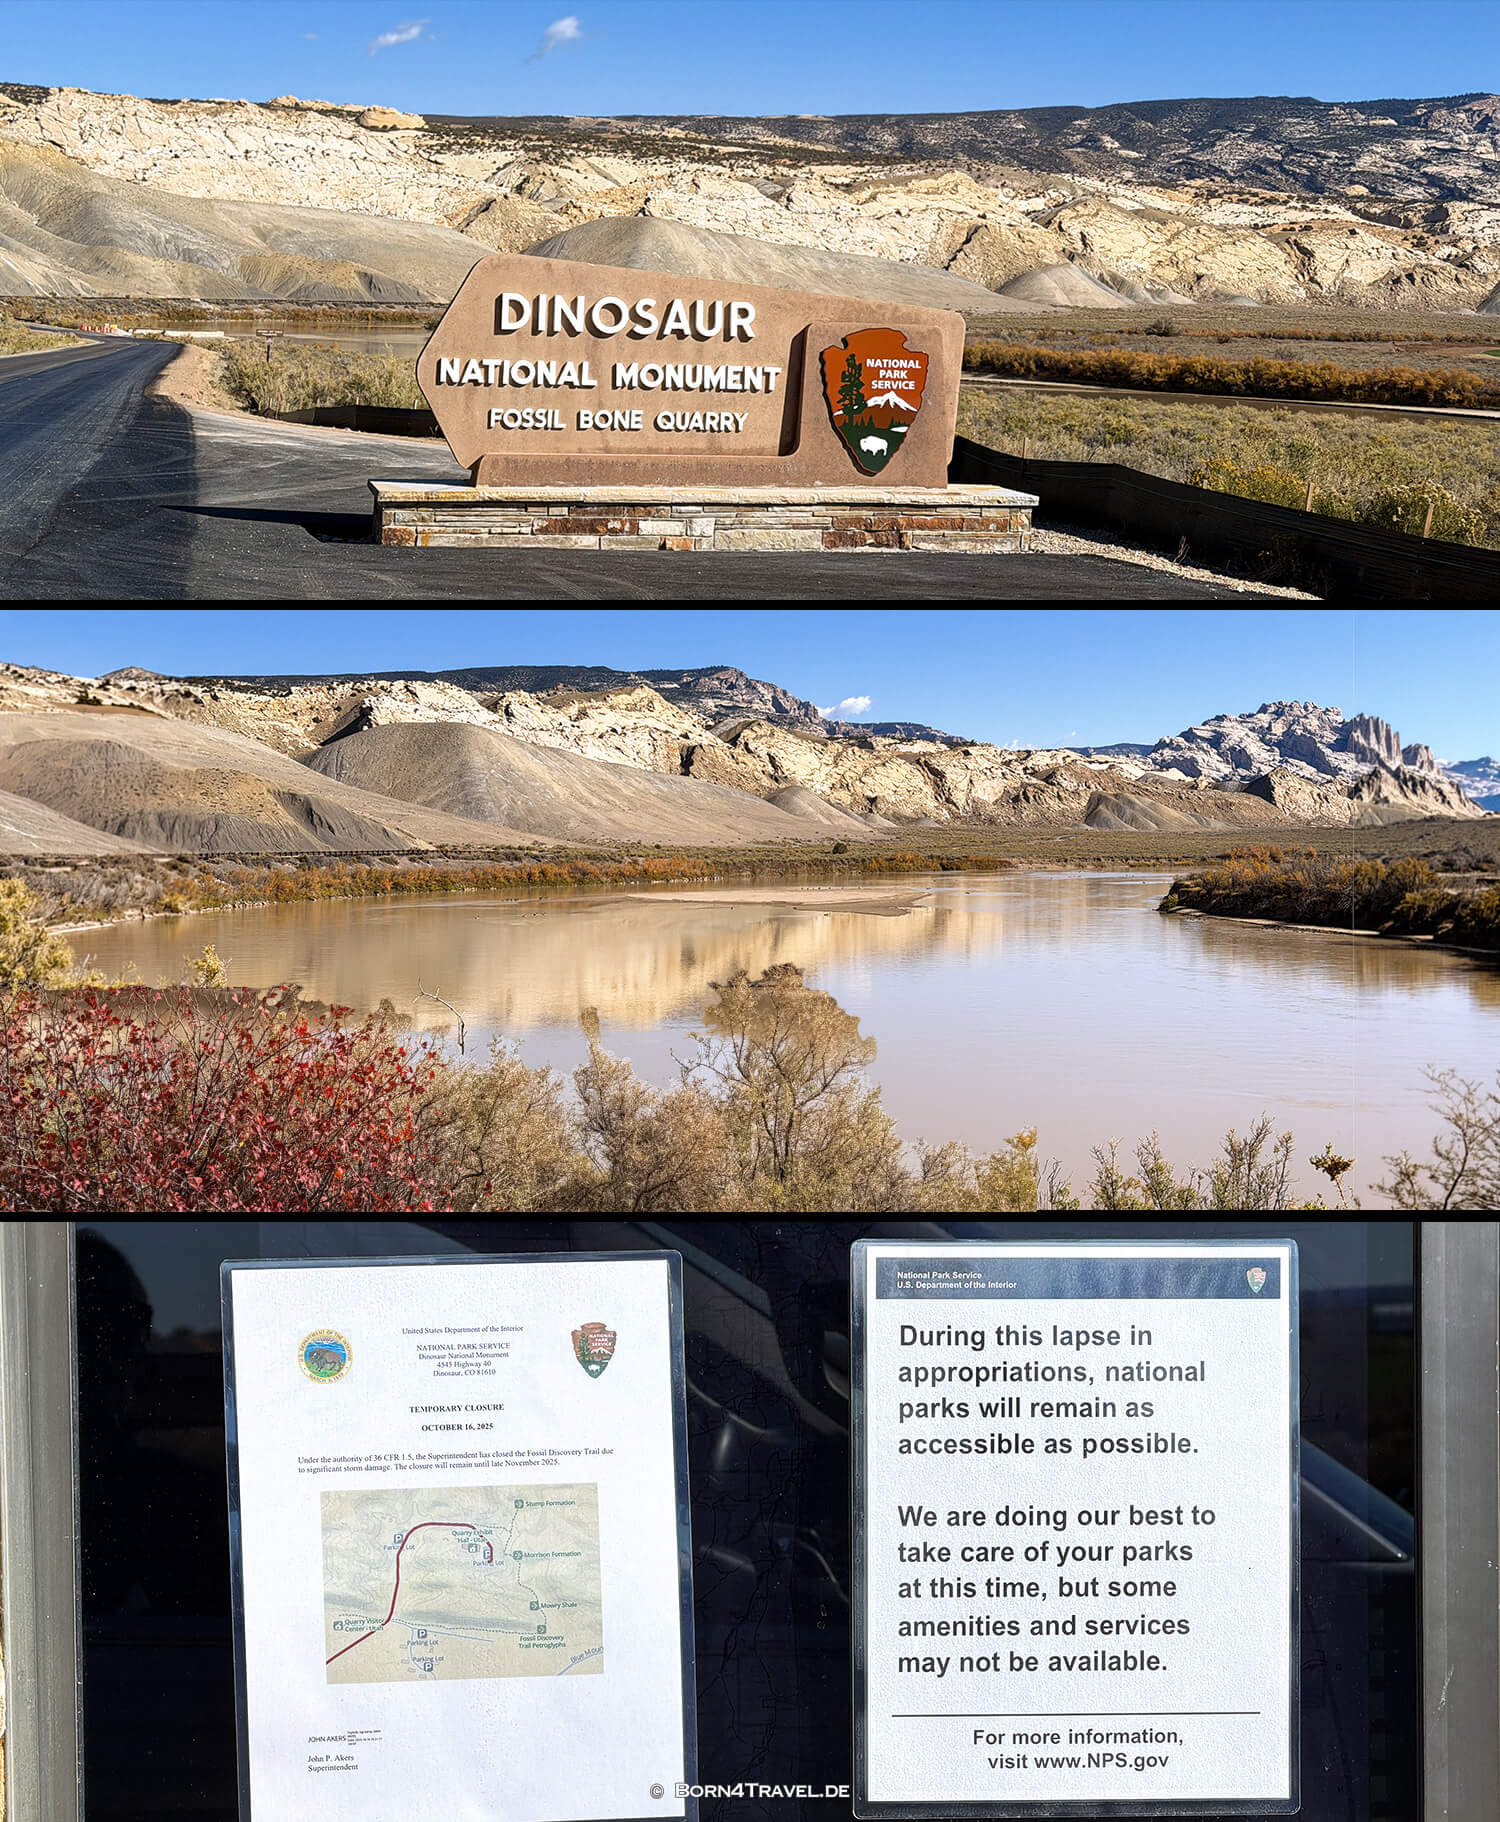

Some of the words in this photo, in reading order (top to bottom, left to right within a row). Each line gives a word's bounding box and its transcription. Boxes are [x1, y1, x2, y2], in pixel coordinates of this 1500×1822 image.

[497, 292, 756, 341] DINOSAUR
[866, 358, 922, 369] NATIONAL
[437, 357, 598, 387] NATIONAL
[612, 362, 782, 392] MONUMENT
[879, 369, 908, 379] PARK
[871, 380, 916, 390] SERVICE
[488, 407, 566, 430] FOSSIL
[577, 409, 643, 431] BONE
[654, 410, 749, 433] QUARRY
[897, 1271, 930, 1279] National
[932, 1271, 950, 1279] Park
[952, 1271, 982, 1279] Service
[897, 1281, 914, 1289] U.S.
[916, 1281, 962, 1290] Department
[964, 1281, 973, 1289] of
[973, 1281, 986, 1289] the
[988, 1281, 1017, 1289] Interior
[900, 1324, 986, 1351] During
[995, 1324, 1043, 1346] this
[1052, 1324, 1121, 1351] lapse
[1130, 1324, 1152, 1346] in
[454, 1361, 481, 1369] Highway
[899, 1361, 1095, 1387] appropriations,
[1105, 1360, 1205, 1382] national
[409, 1405, 462, 1413] TEMPORARY
[899, 1397, 970, 1423] parks
[979, 1397, 1021, 1418] will
[1030, 1397, 1116, 1418] remain
[1125, 1402, 1154, 1418] as
[421, 1423, 463, 1431] OCTOBER
[465, 1423, 475, 1431] 16,
[477, 1422, 494, 1430] 2025
[899, 1433, 1034, 1455] accessible
[1044, 1438, 1072, 1455] as
[1083, 1433, 1199, 1458] possible.
[298, 1456, 319, 1464] Under
[332, 1455, 362, 1464] authority
[364, 1454, 372, 1462] of
[428, 1452, 478, 1460] Superintendent
[492, 1450, 513, 1458] closed
[527, 1449, 547, 1457] Fossil
[549, 1448, 582, 1457] Discovery
[307, 1465, 342, 1475] significant
[364, 1464, 392, 1472] damage.
[408, 1462, 433, 1470] closure
[474, 1460, 489, 1468] until
[505, 1459, 539, 1467] November
[541, 1458, 560, 1466] 2025.
[898, 1505, 937, 1527] We
[947, 1510, 986, 1527] are
[995, 1505, 1067, 1531] doing
[1077, 1509, 1120, 1527] our
[1129, 1505, 1183, 1526] best
[1192, 1505, 1216, 1526] to
[898, 1542, 951, 1563] take
[960, 1545, 1014, 1563] care
[1024, 1541, 1049, 1562] of
[1056, 1544, 1113, 1566] your
[1122, 1540, 1193, 1566] parks
[898, 1578, 921, 1599] at
[930, 1577, 976, 1598] this
[985, 1577, 1047, 1601] time,
[1058, 1577, 1099, 1597] but
[1108, 1579, 1176, 1597] some
[898, 1616, 1020, 1636] amenities
[1030, 1615, 1076, 1636] and
[1085, 1615, 1190, 1635] services
[898, 1655, 950, 1678] may
[959, 1652, 1000, 1672] not
[1009, 1651, 1038, 1672] be
[1048, 1650, 1167, 1671] available.
[973, 1730, 1005, 1746] For
[1012, 1732, 1061, 1746] more
[1068, 1728, 1183, 1746] information,
[308, 1764, 358, 1773] Superintendent
[988, 1753, 1028, 1770] visit
[1034, 1752, 1169, 1771] www.NPS.gov
